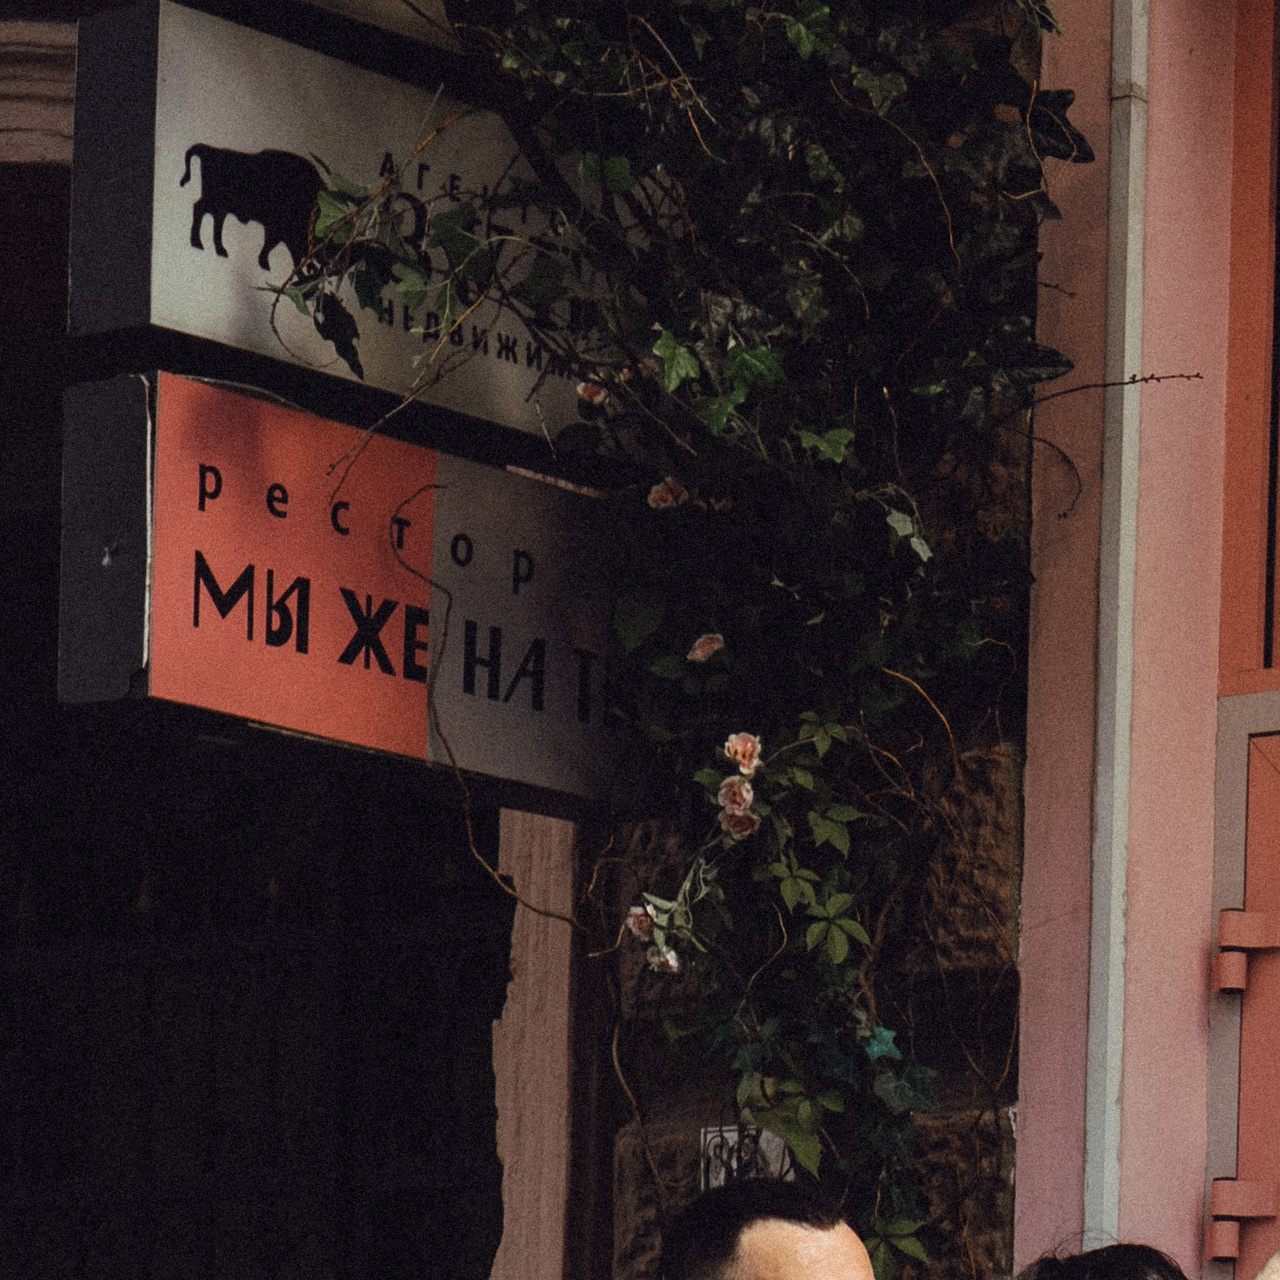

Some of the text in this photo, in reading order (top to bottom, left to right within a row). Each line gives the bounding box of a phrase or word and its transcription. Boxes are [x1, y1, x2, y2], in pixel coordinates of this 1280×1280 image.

[196, 463, 536, 593] рестор
[192, 550, 311, 654] МЫ
[338, 588, 429, 684] ЖЕ
[462, 619, 545, 711] НА
